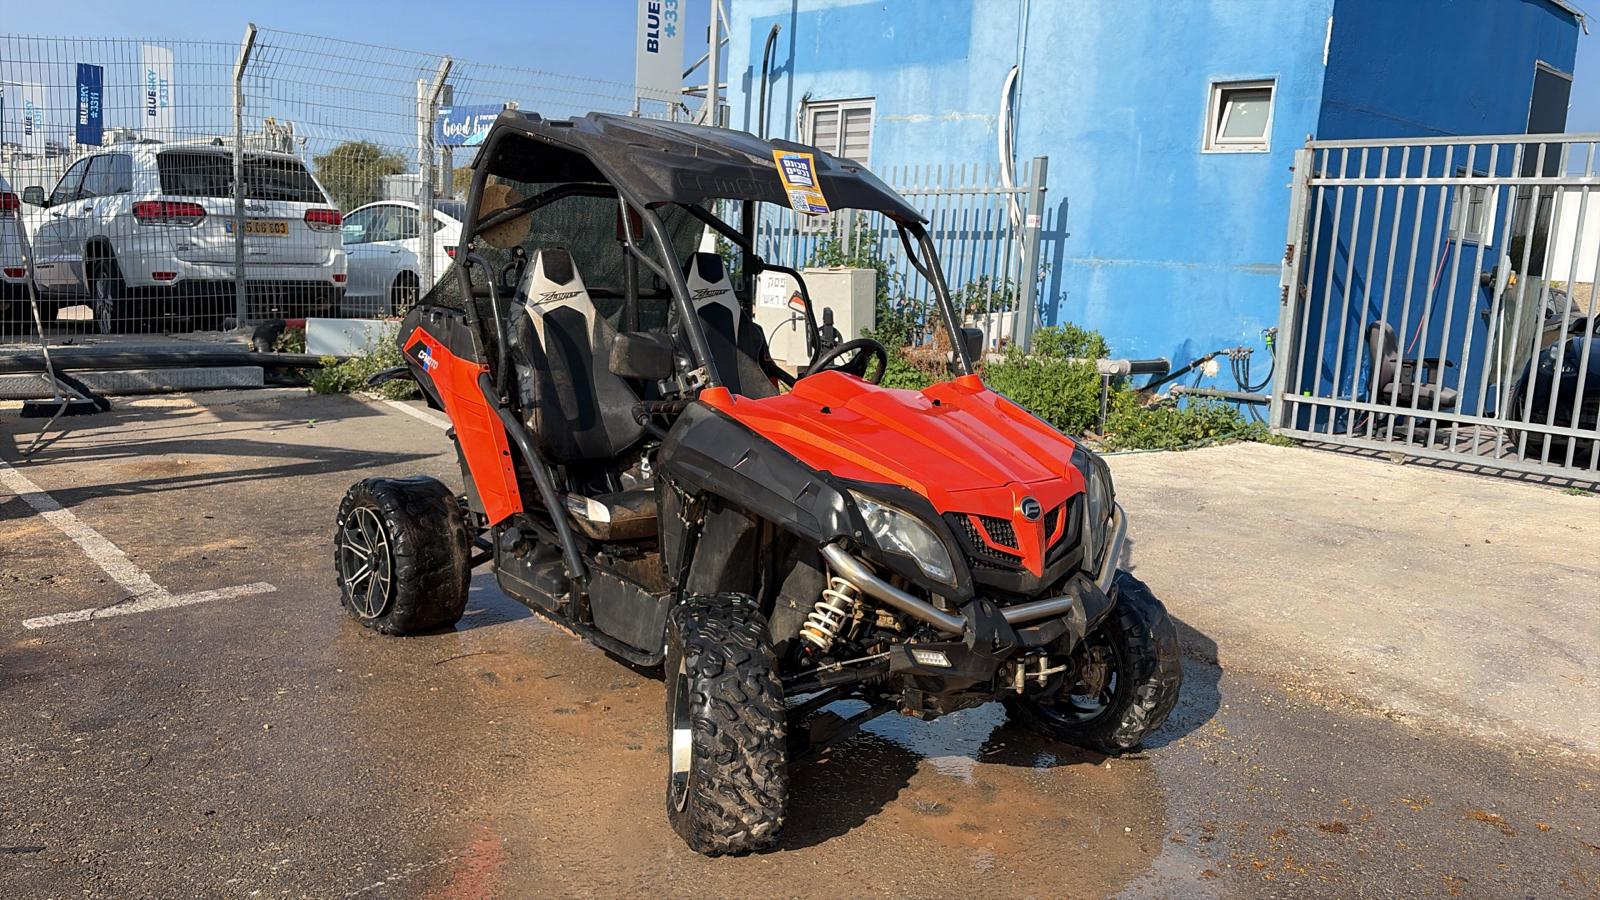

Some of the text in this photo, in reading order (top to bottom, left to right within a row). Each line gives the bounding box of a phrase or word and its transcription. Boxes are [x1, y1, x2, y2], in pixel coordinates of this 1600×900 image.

[647, 0, 660, 53] BLUE
[80, 83, 89, 125] BLUESKY
[147, 69, 157, 117] BLUESKY
[443, 115, 471, 137] Good
